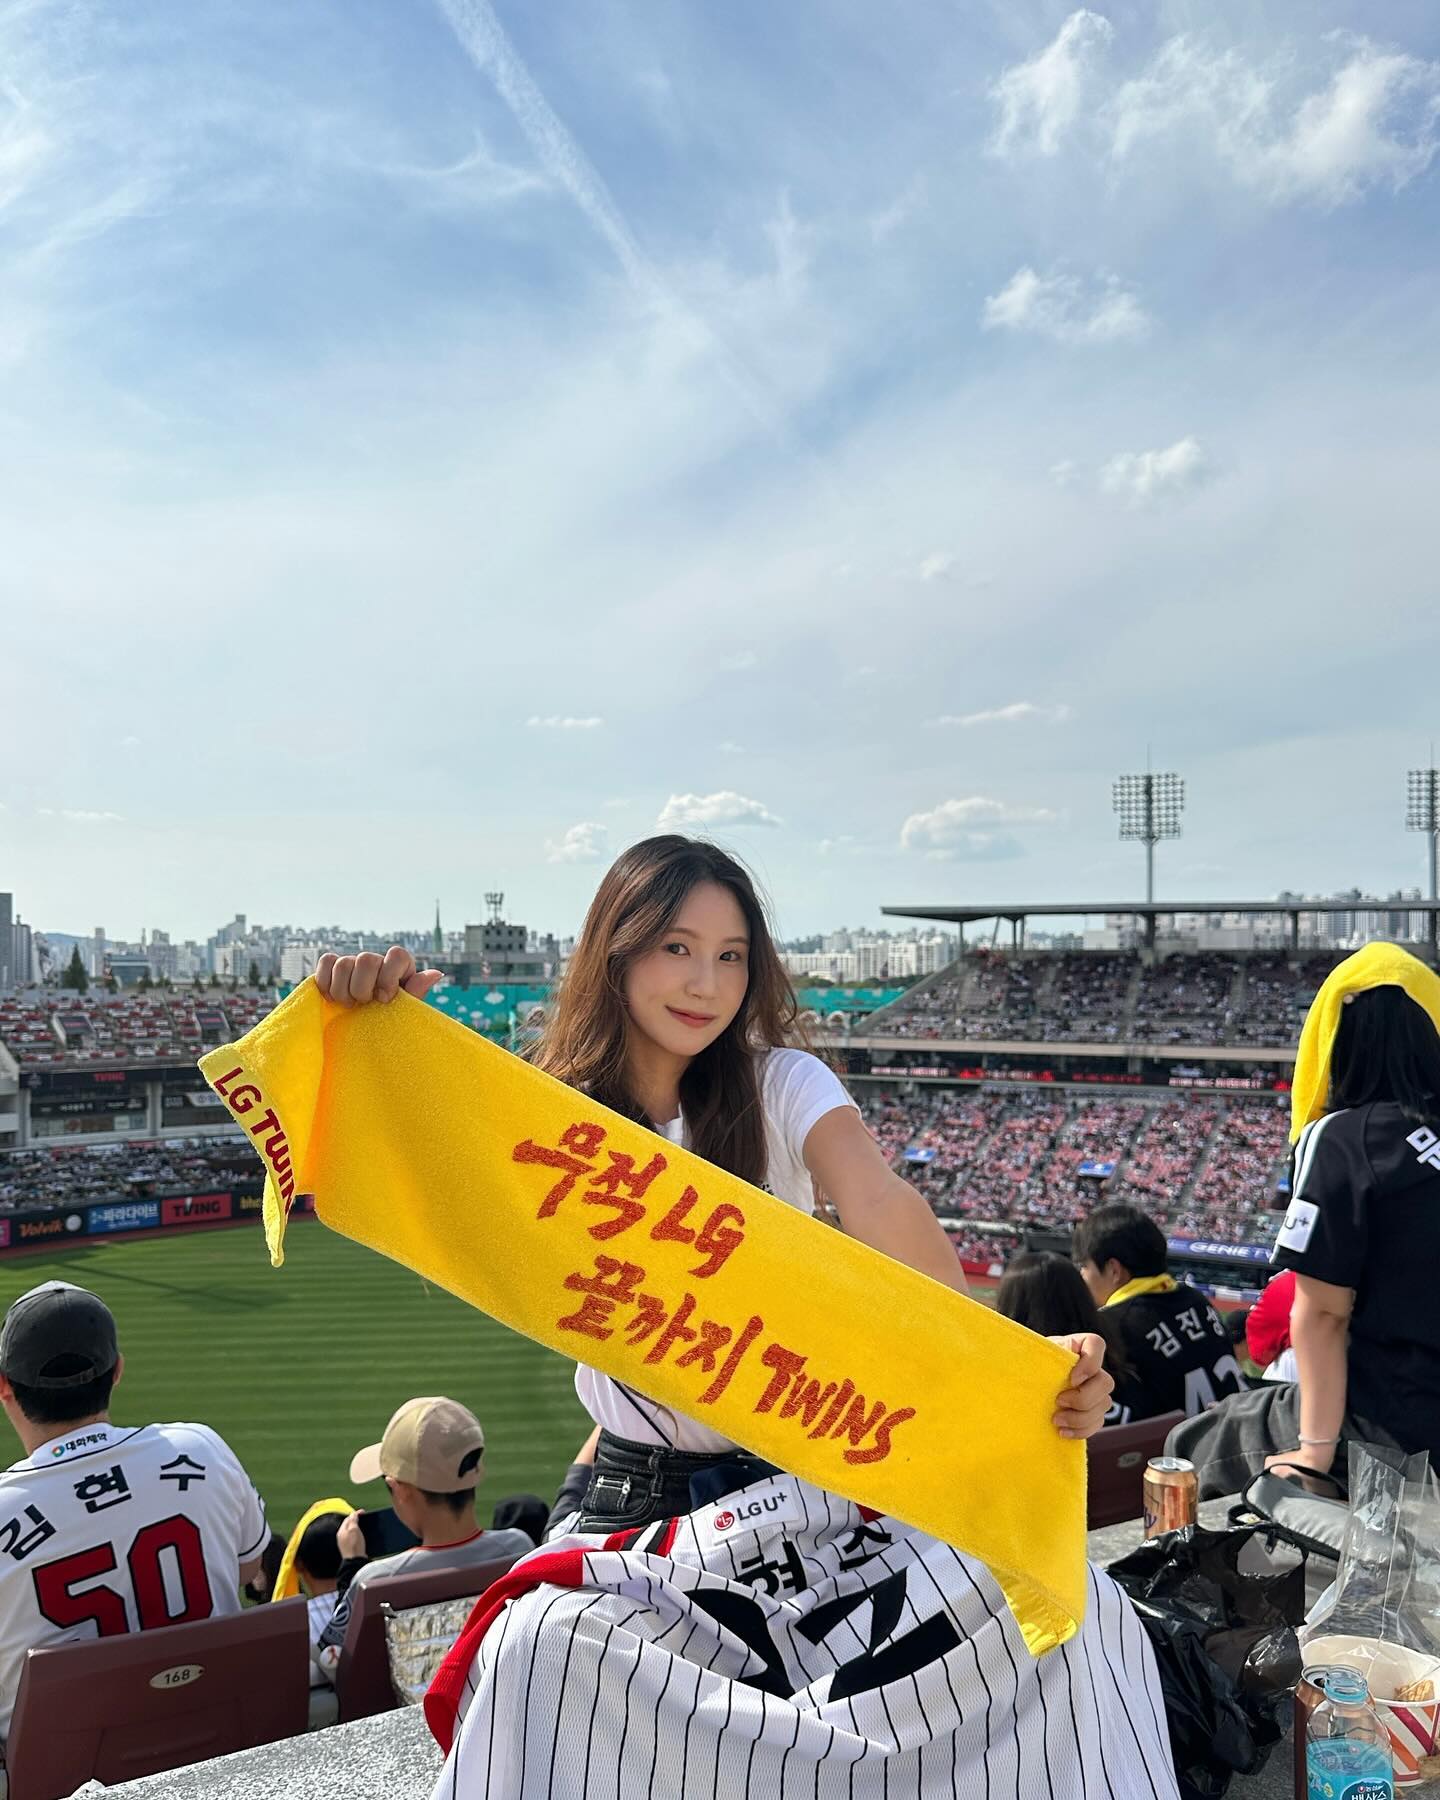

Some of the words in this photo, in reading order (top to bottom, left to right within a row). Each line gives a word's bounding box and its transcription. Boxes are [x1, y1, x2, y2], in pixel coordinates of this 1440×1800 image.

[213, 1067, 262, 1114] LG
[512, 1121, 668, 1240] 무적
[650, 1185, 746, 1278] LG
[556, 1254, 764, 1405] 끝까지
[753, 1343, 916, 1465] TWINS
[736, 1501, 762, 1521] LG
[763, 1492, 787, 1512] U+
[32, 1513, 214, 1638] 50
[164, 1668, 191, 1685] 168
